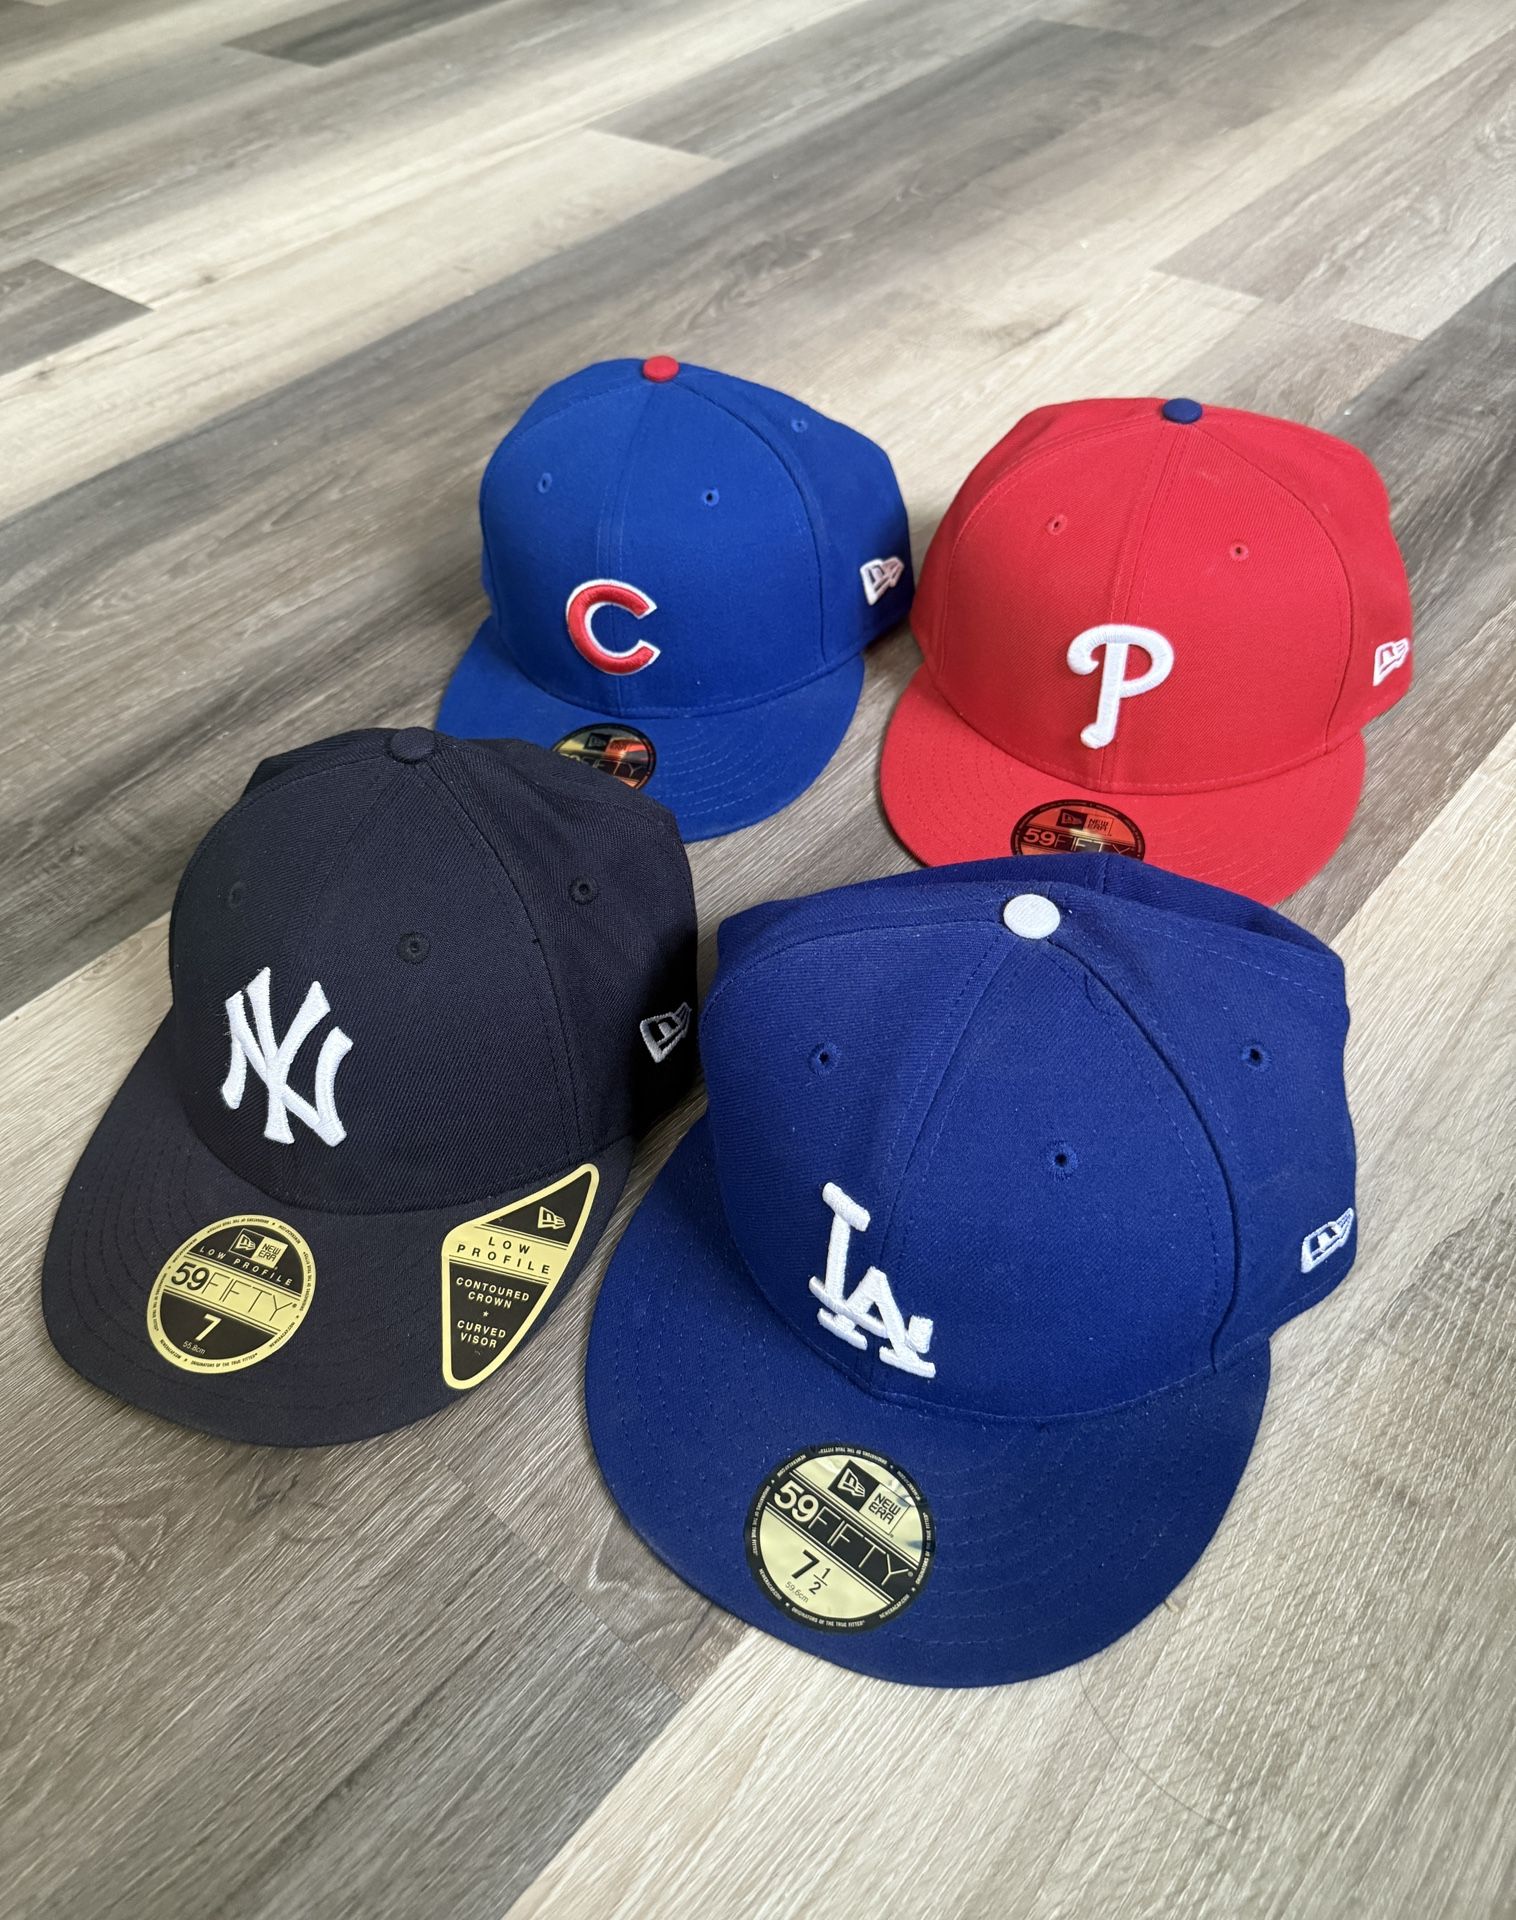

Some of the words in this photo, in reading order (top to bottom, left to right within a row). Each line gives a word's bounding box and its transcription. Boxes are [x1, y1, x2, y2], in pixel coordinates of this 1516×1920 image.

[565, 578, 661, 676] C
[1066, 624, 1175, 749] P
[222, 966, 354, 1147] NY
[259, 1250, 277, 1262] ERA
[262, 1243, 282, 1255] NEW
[488, 1236, 531, 1254] LOW
[200, 1246, 226, 1260] LOW
[233, 1258, 293, 1286] PROFILE
[456, 1244, 551, 1275] PROFILE
[171, 1261, 293, 1322] 59FIFTY
[455, 1276, 530, 1301] CONTOURED
[809, 1182, 936, 1378] LA
[468, 1291, 512, 1309] CROWN
[195, 1313, 222, 1342] 7
[457, 1319, 507, 1338] CURVED
[460, 1333, 497, 1348] VISOR
[182, 1340, 206, 1355] 55.8cm
[868, 1502, 894, 1525] ERA
[876, 1492, 900, 1515] NEW
[774, 1480, 909, 1586] 59FIFTY
[792, 1550, 820, 1580] 7
